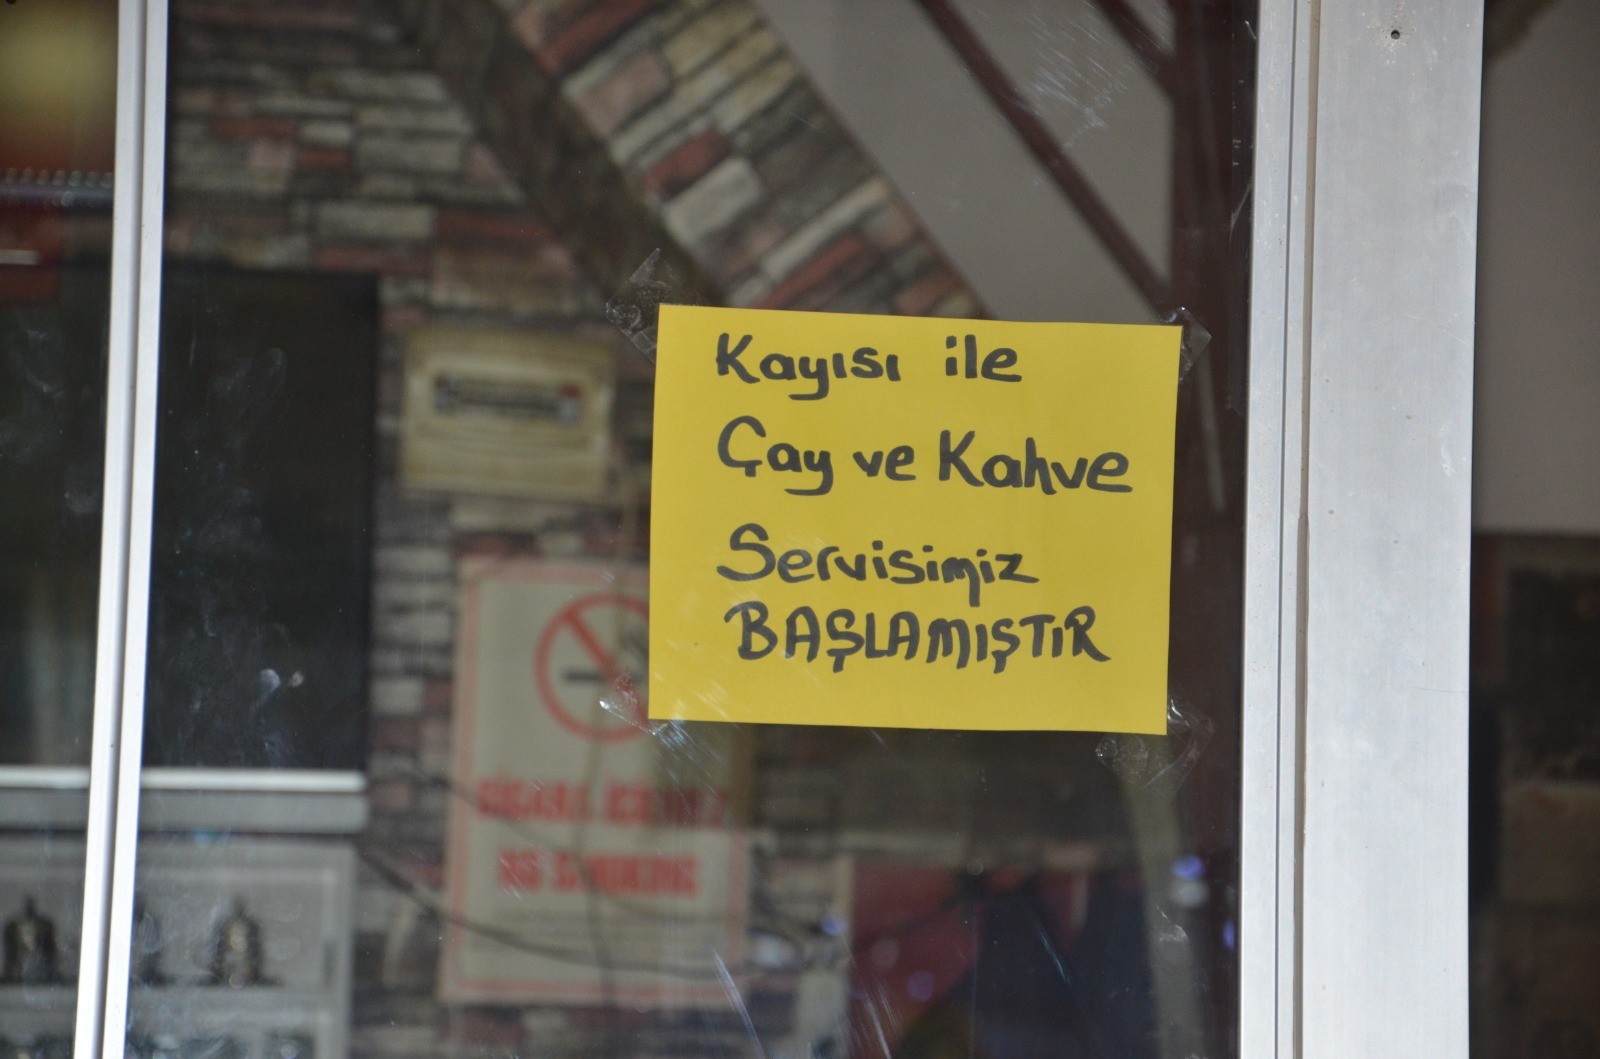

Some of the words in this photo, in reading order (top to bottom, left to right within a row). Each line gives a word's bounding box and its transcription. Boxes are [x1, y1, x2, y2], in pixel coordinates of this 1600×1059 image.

[715, 332, 901, 401] Kayısı
[945, 334, 1023, 383] ile
[717, 415, 834, 497] Çay
[852, 445, 917, 482] ve
[938, 429, 1133, 496] Kahve
[716, 522, 1040, 608] Servisimiz
[723, 600, 1111, 675] BAŞLAMIŞTIR
